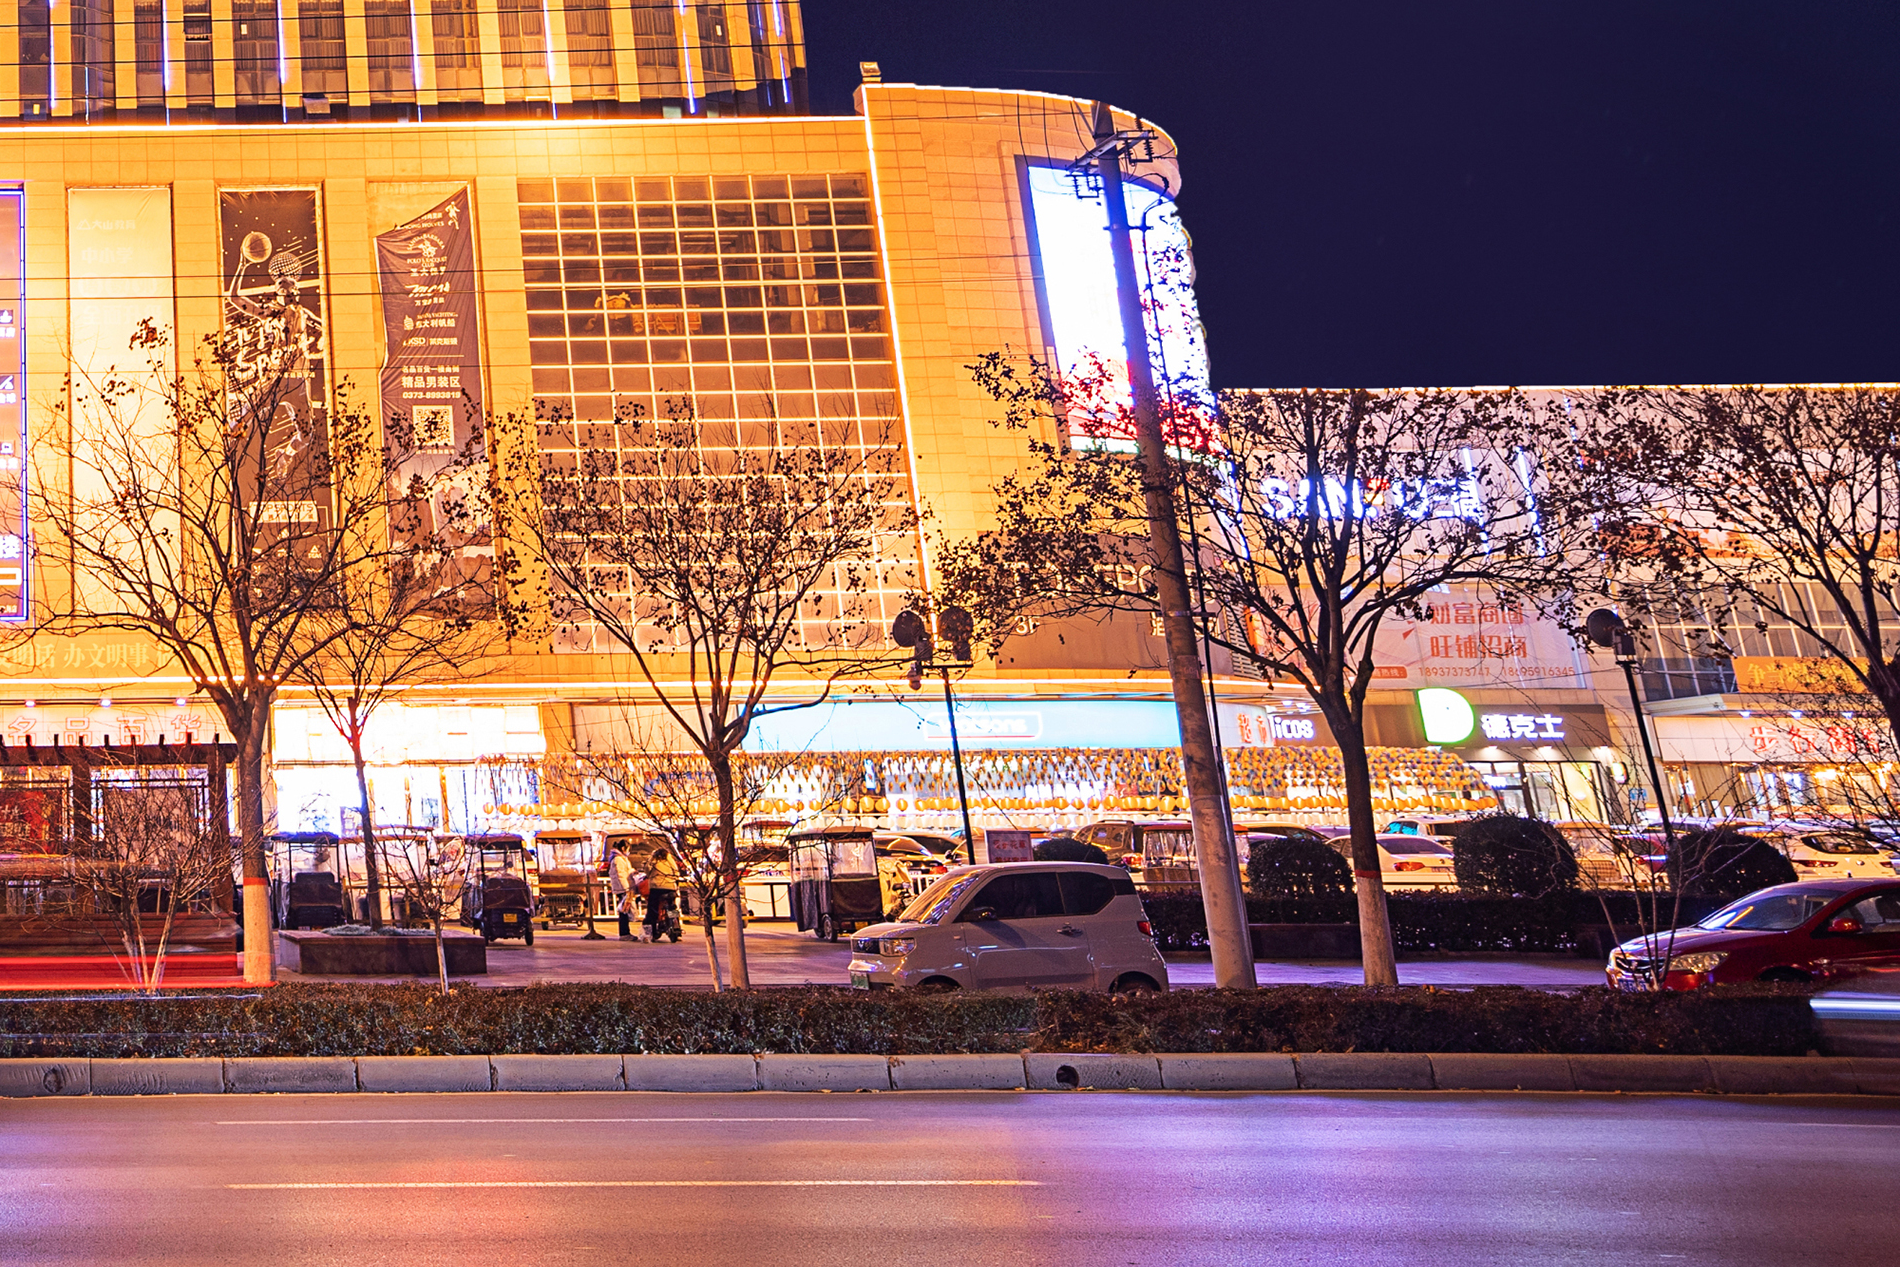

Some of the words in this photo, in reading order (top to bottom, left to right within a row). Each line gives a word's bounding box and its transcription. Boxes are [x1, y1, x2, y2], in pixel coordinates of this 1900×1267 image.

[81, 247, 133, 265] 中小学
[401, 376, 461, 388] 精品男装区
[1429, 601, 1525, 625] 财富商圈
[63, 643, 150, 670] 办文明事
[1430, 635, 1528, 659] 旺铺招商
[8, 714, 202, 746] 名品百货
[1481, 713, 1565, 739] 德克士
